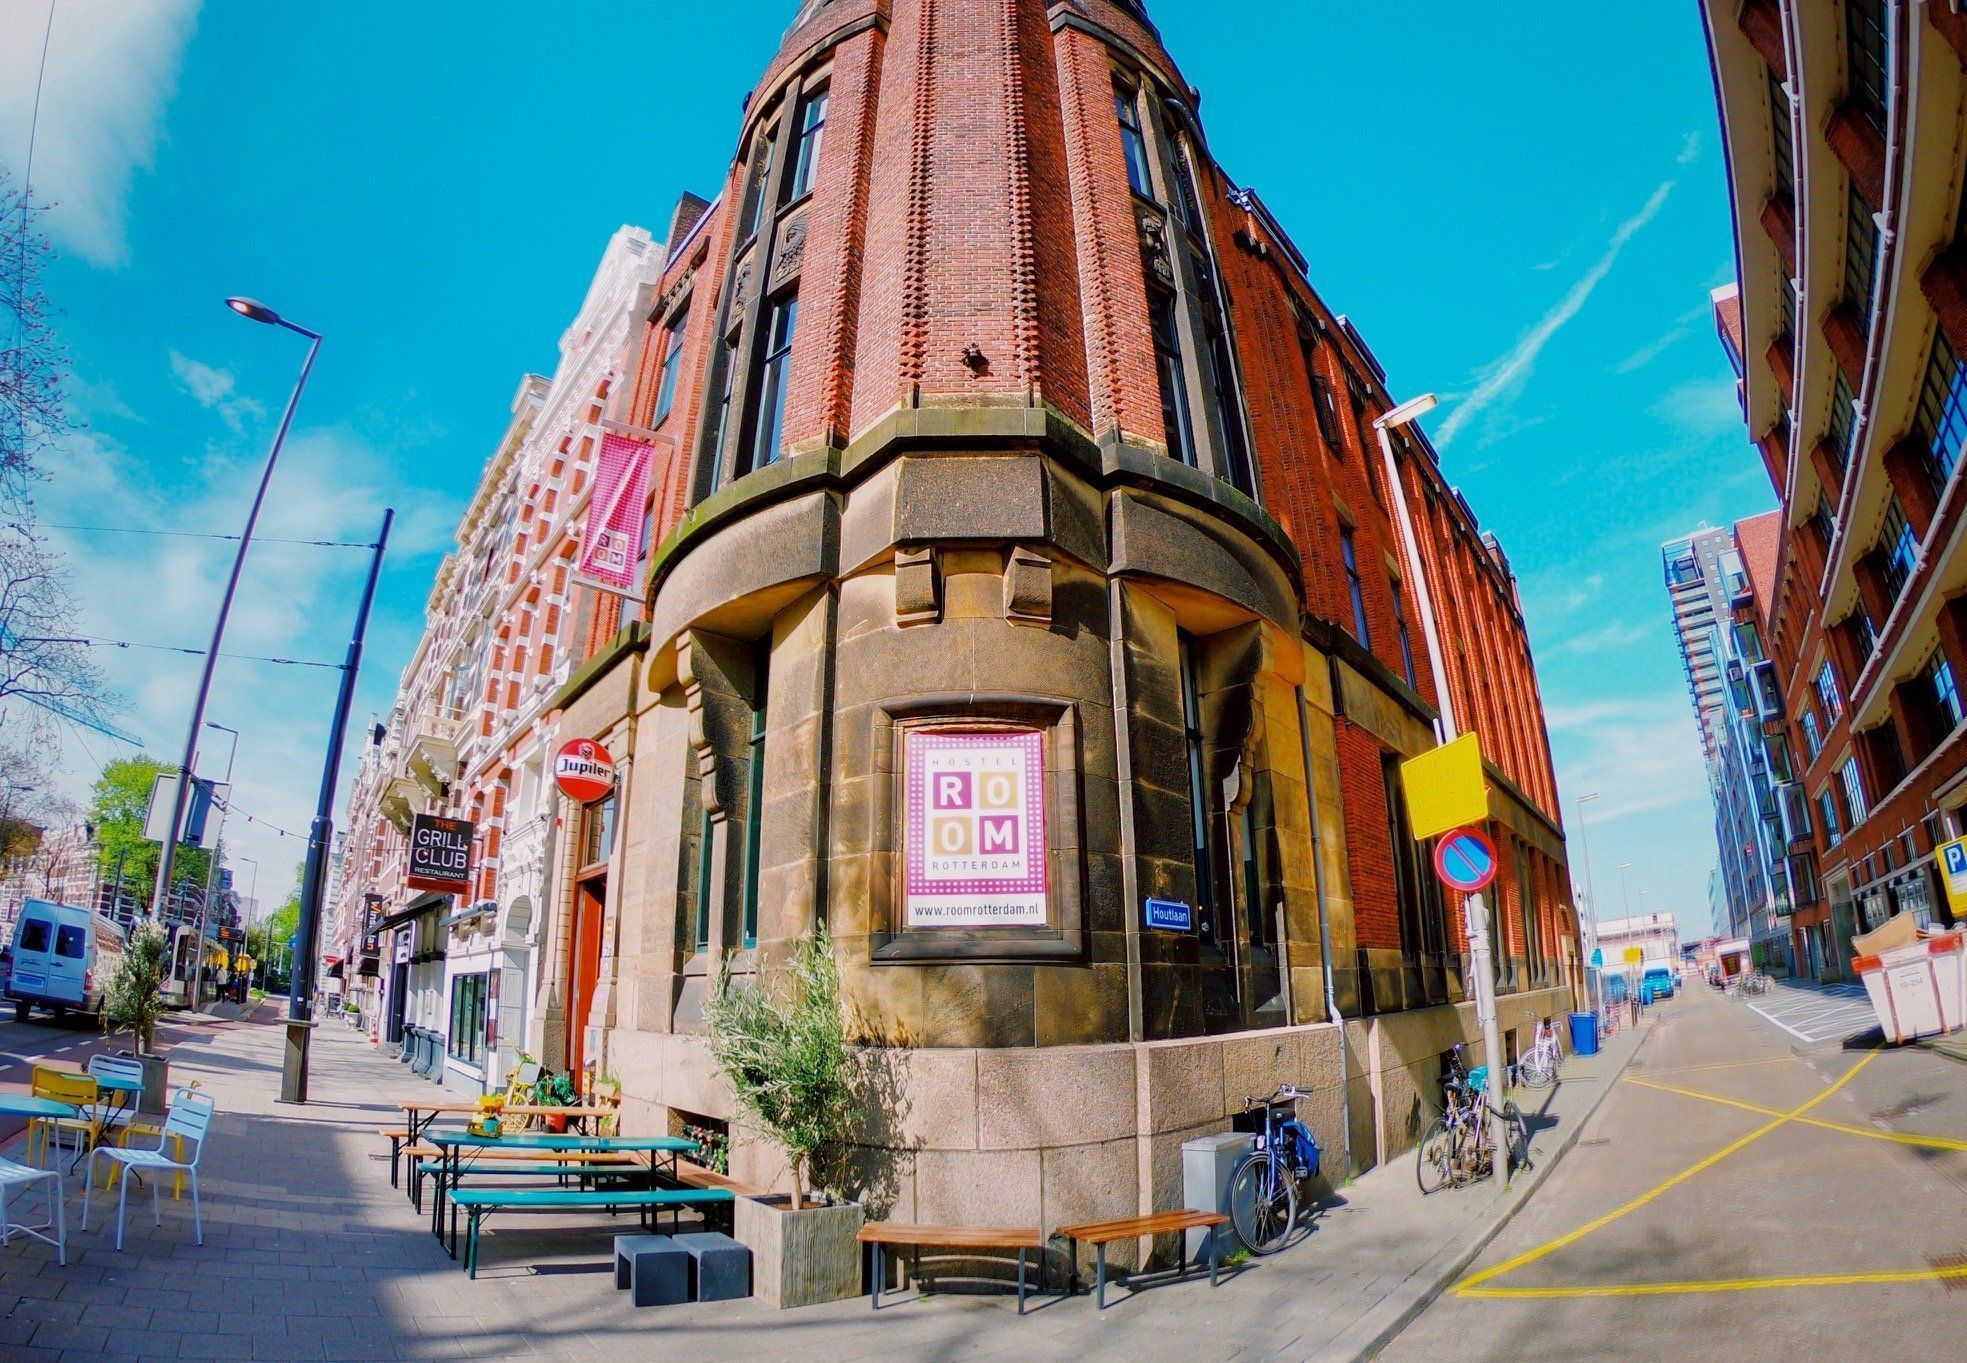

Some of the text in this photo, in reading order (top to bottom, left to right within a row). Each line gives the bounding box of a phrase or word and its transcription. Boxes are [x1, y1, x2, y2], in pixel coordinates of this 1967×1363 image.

[558, 758, 611, 778] Jupiler
[932, 757, 1016, 767] HOSTEL
[434, 819, 458, 831] THE
[417, 828, 468, 851] GRILL
[415, 847, 467, 869] CLUB
[932, 860, 1020, 870] ROTTERDAM
[414, 867, 466, 879] RESTAURANT
[914, 902, 1039, 916] www.roomrotterdam.nl
[1153, 906, 1188, 922] Houtlaan
